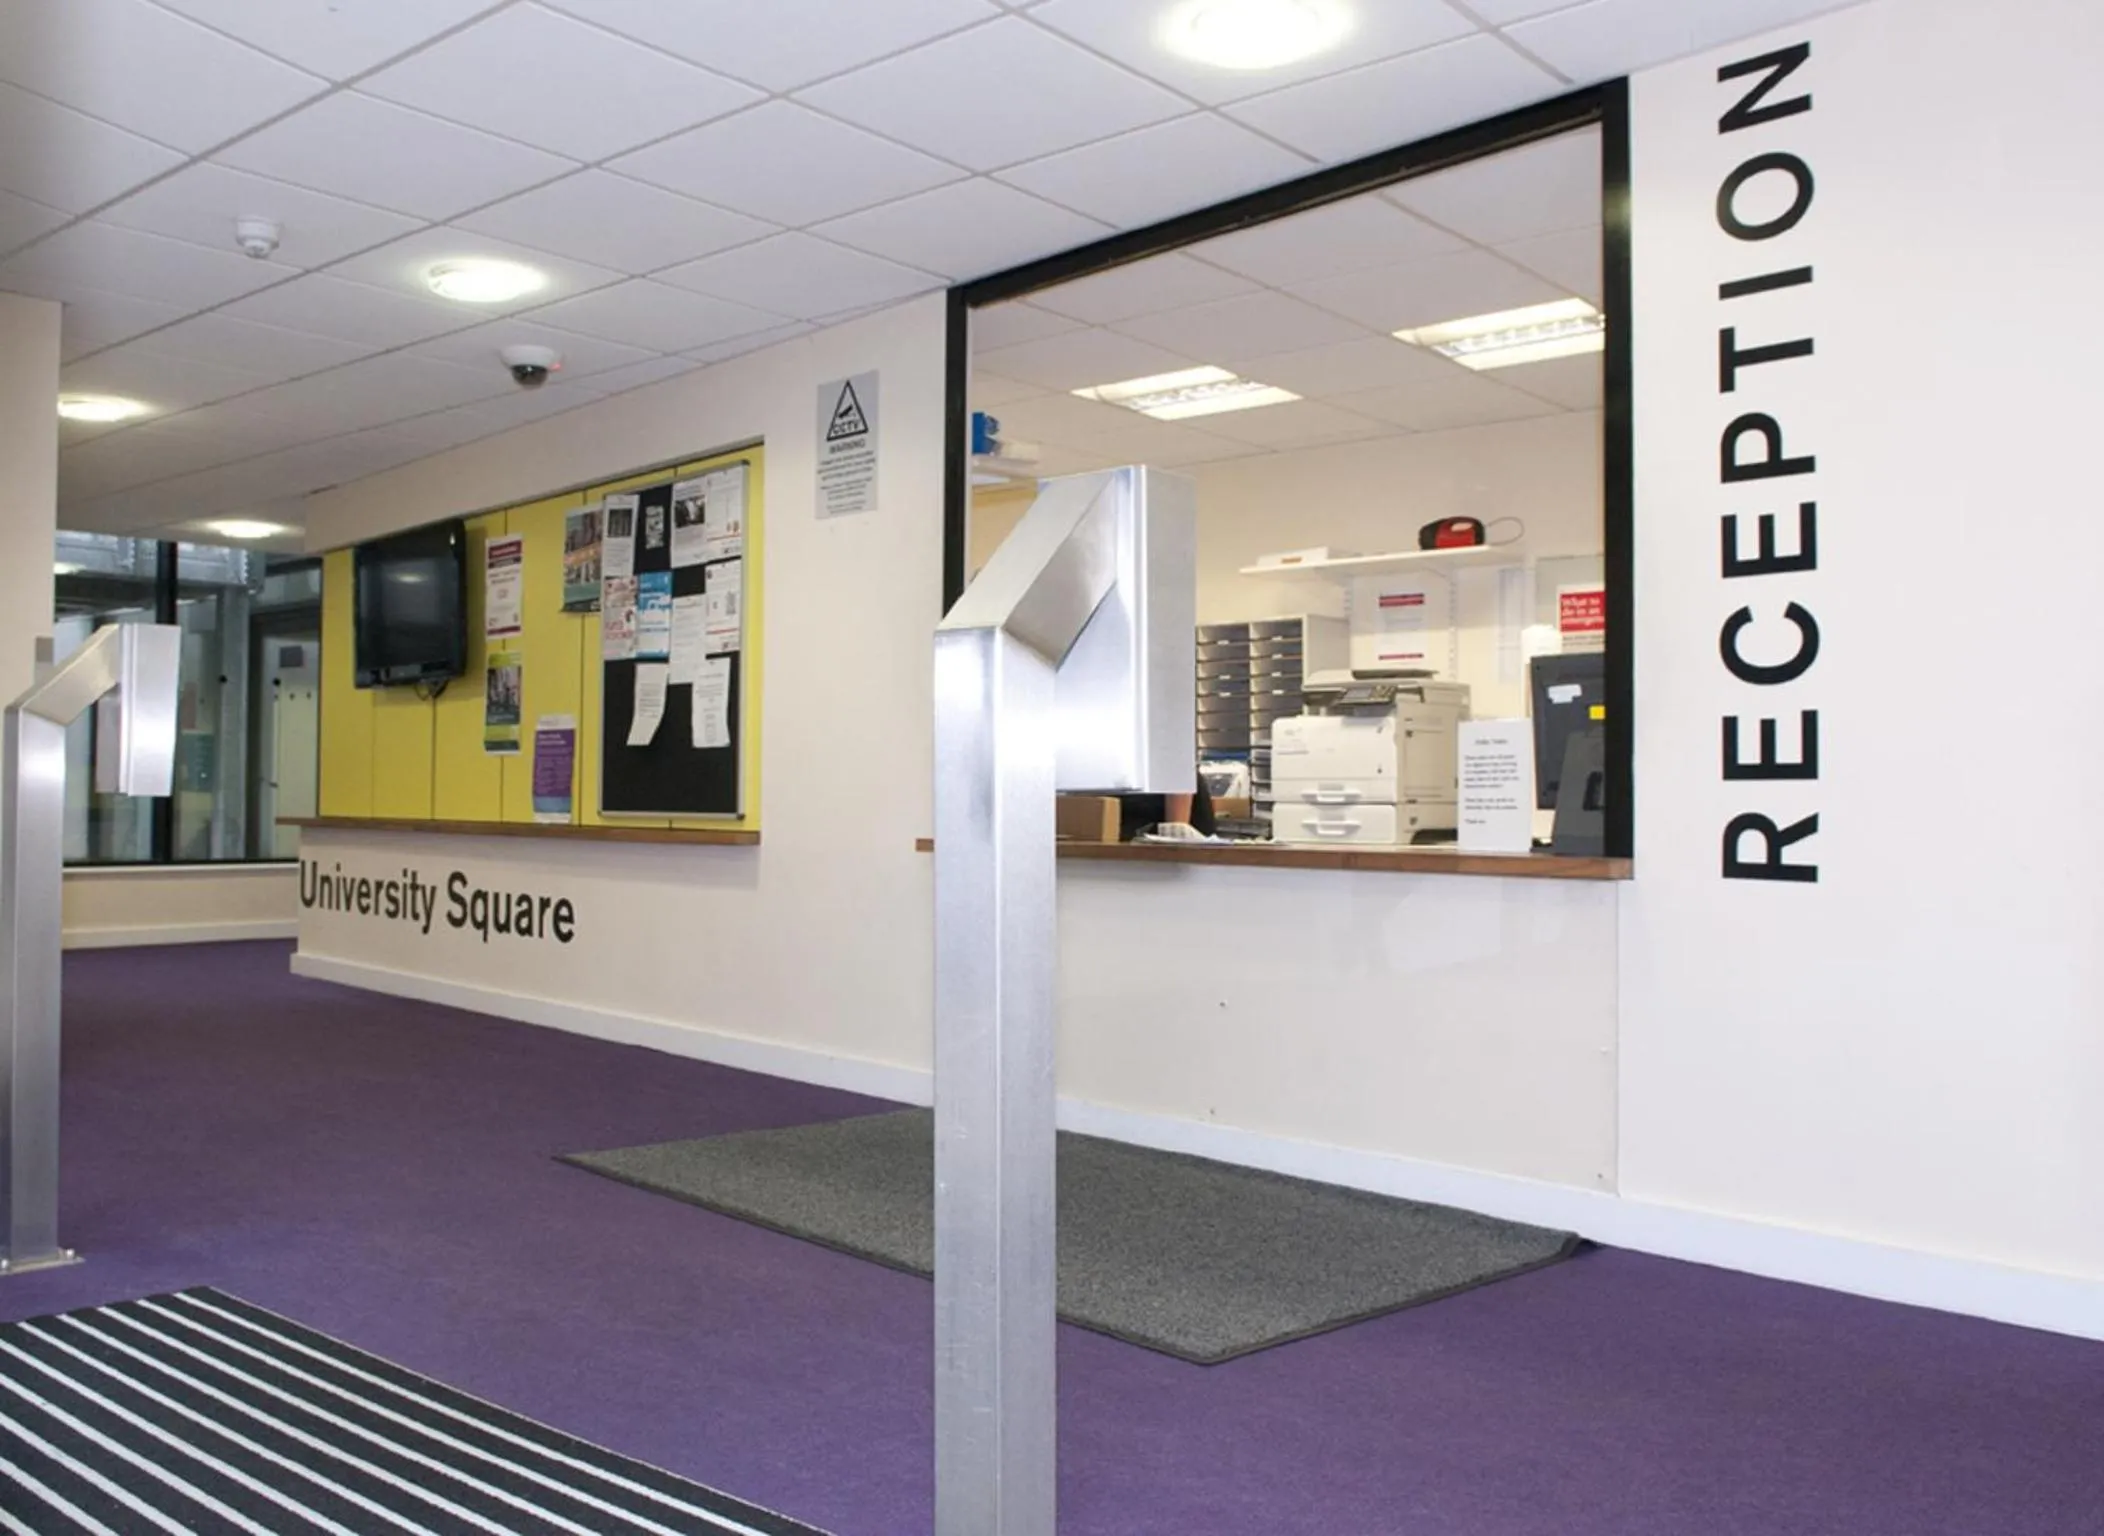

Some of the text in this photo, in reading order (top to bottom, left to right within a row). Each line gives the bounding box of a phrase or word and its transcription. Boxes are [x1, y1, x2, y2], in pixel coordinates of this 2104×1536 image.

[829, 438, 866, 454] WARNING
[832, 420, 860, 435] CCTV
[1717, 42, 1819, 883] RECEPTION
[299, 859, 574, 943] University Square
